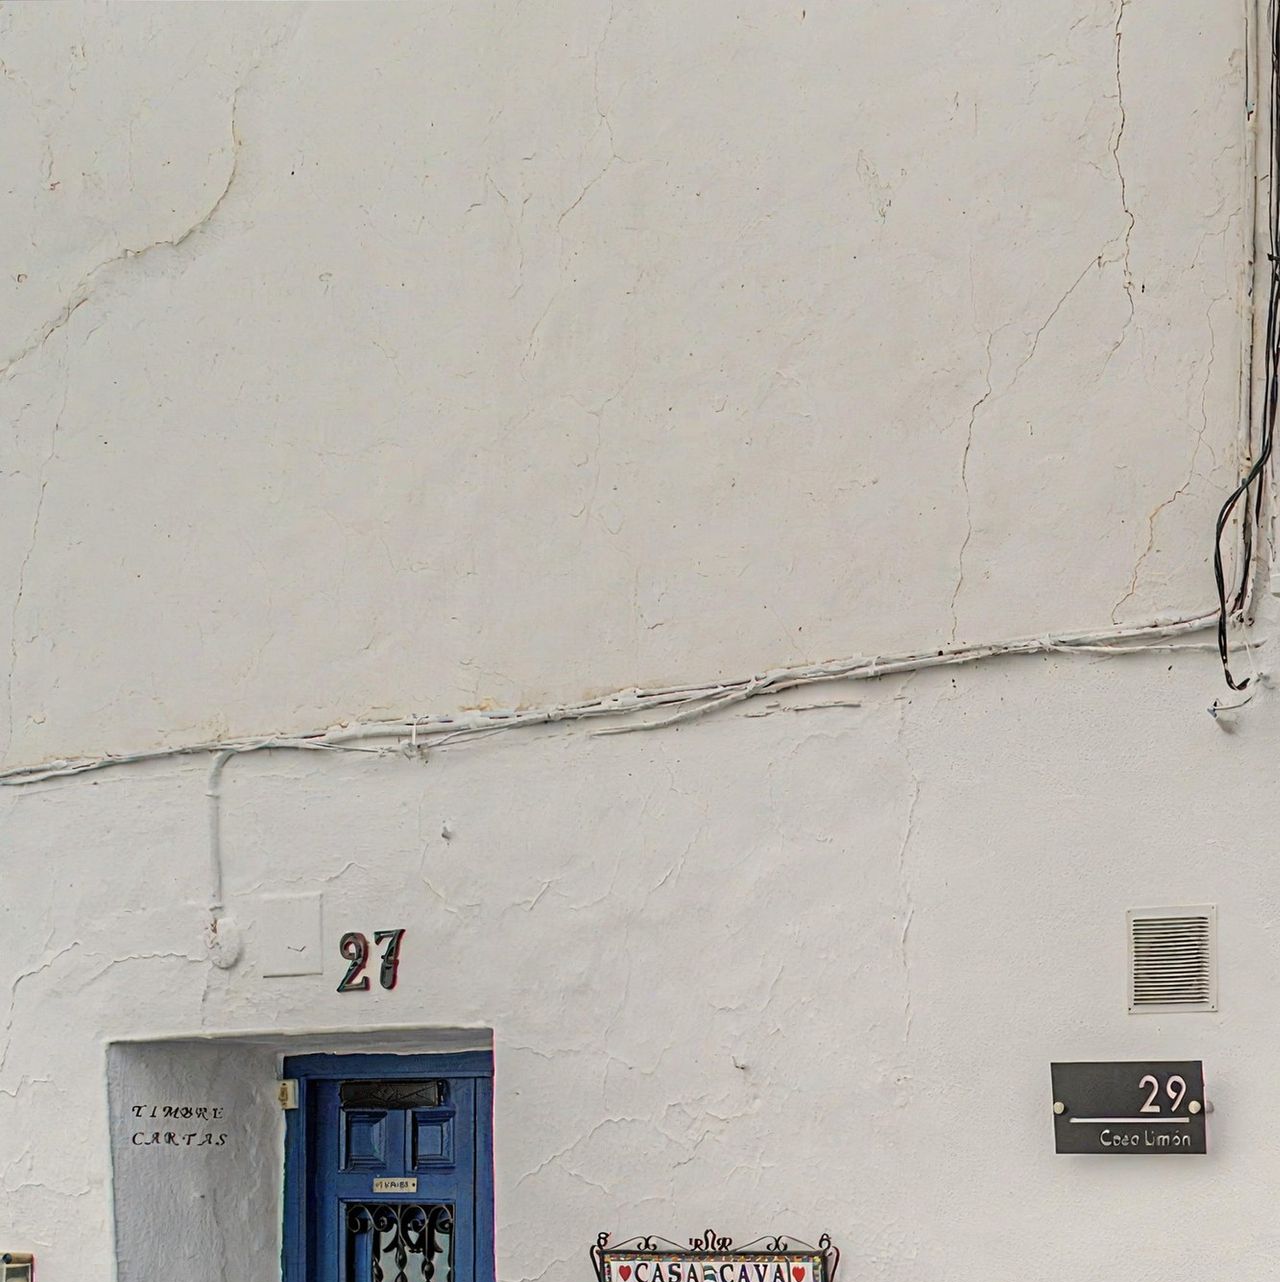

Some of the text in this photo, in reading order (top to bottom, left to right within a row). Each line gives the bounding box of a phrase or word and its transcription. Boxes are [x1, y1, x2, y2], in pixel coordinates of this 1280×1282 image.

[336, 929, 406, 992] 27
[1138, 1074, 1187, 1113] 29
[131, 1131, 228, 1146] CARTAS
